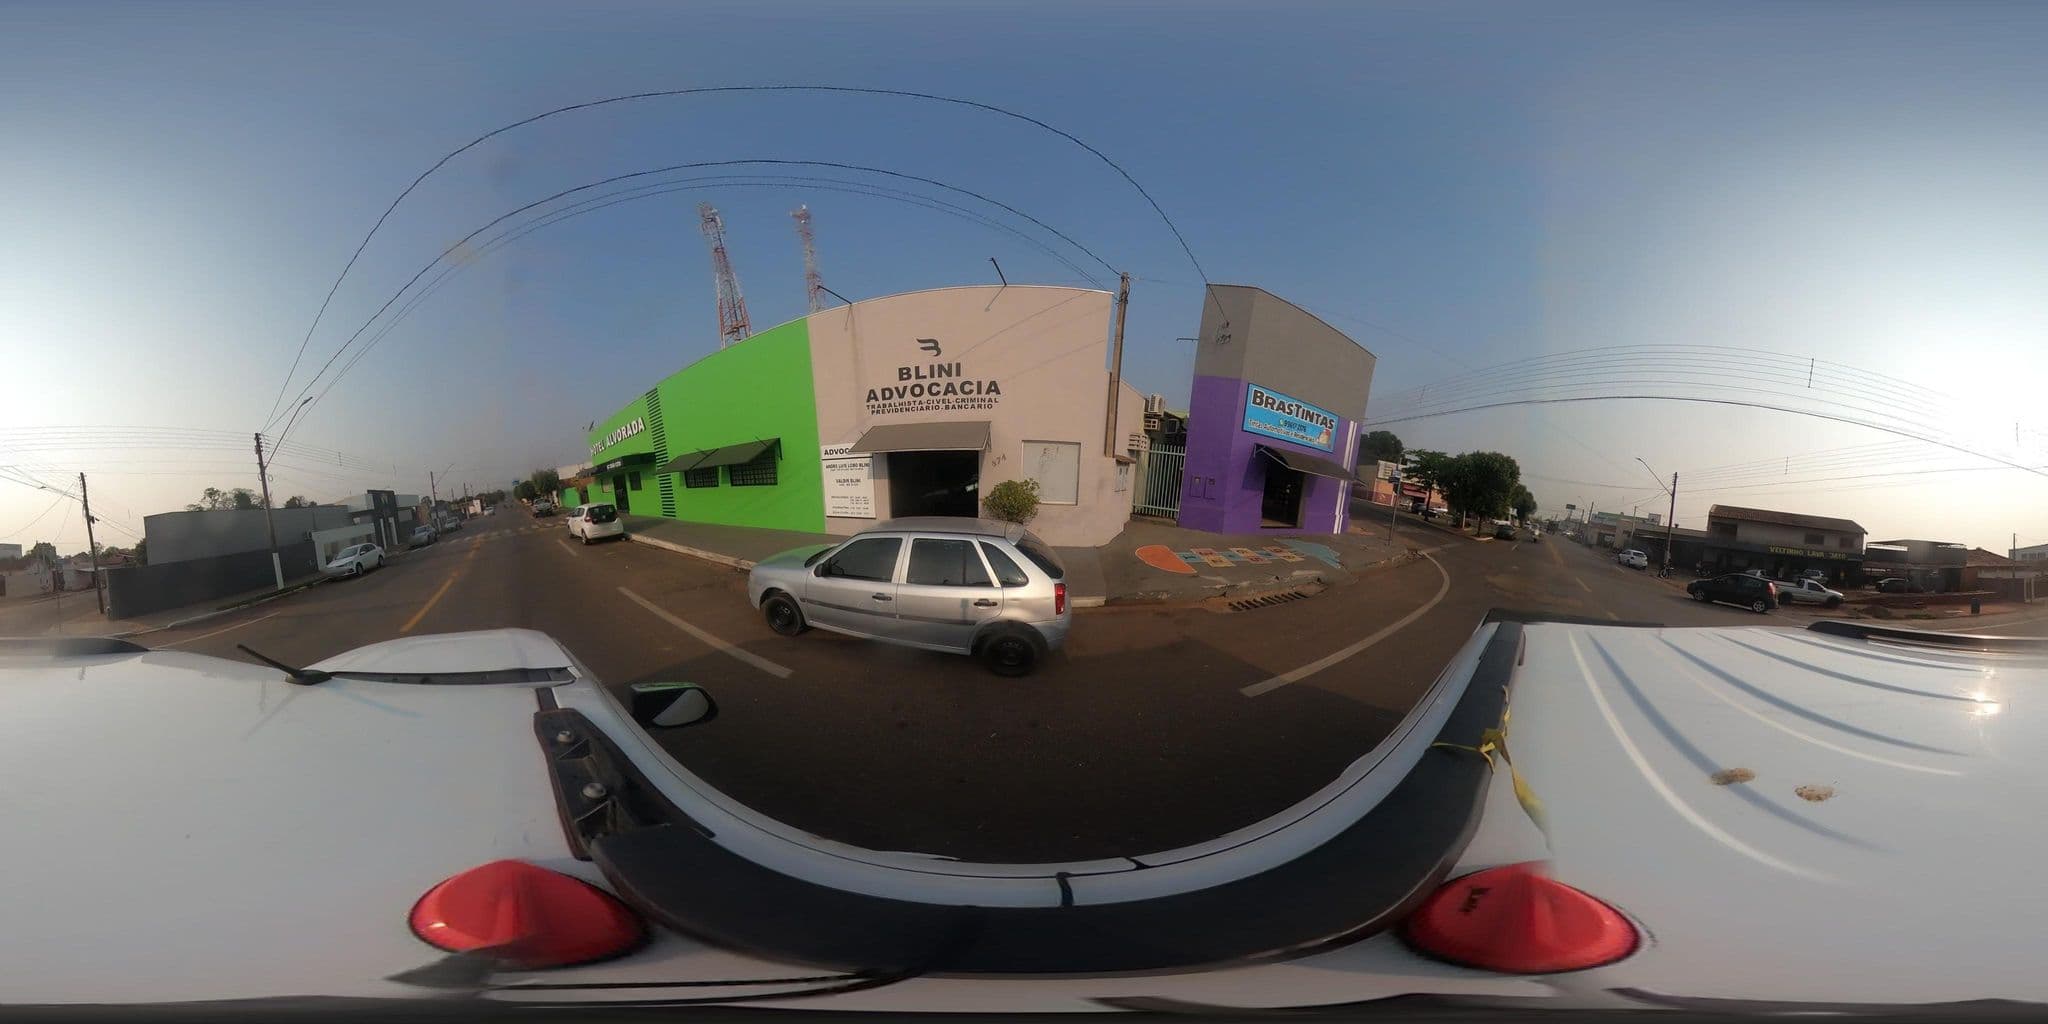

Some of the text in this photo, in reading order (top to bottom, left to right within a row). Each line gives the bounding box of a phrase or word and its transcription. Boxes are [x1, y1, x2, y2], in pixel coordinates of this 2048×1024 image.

[898, 362, 961, 381] BLINI
[866, 380, 1001, 403] ADVOCACIA
[606, 416, 646, 448] ALVORADA
